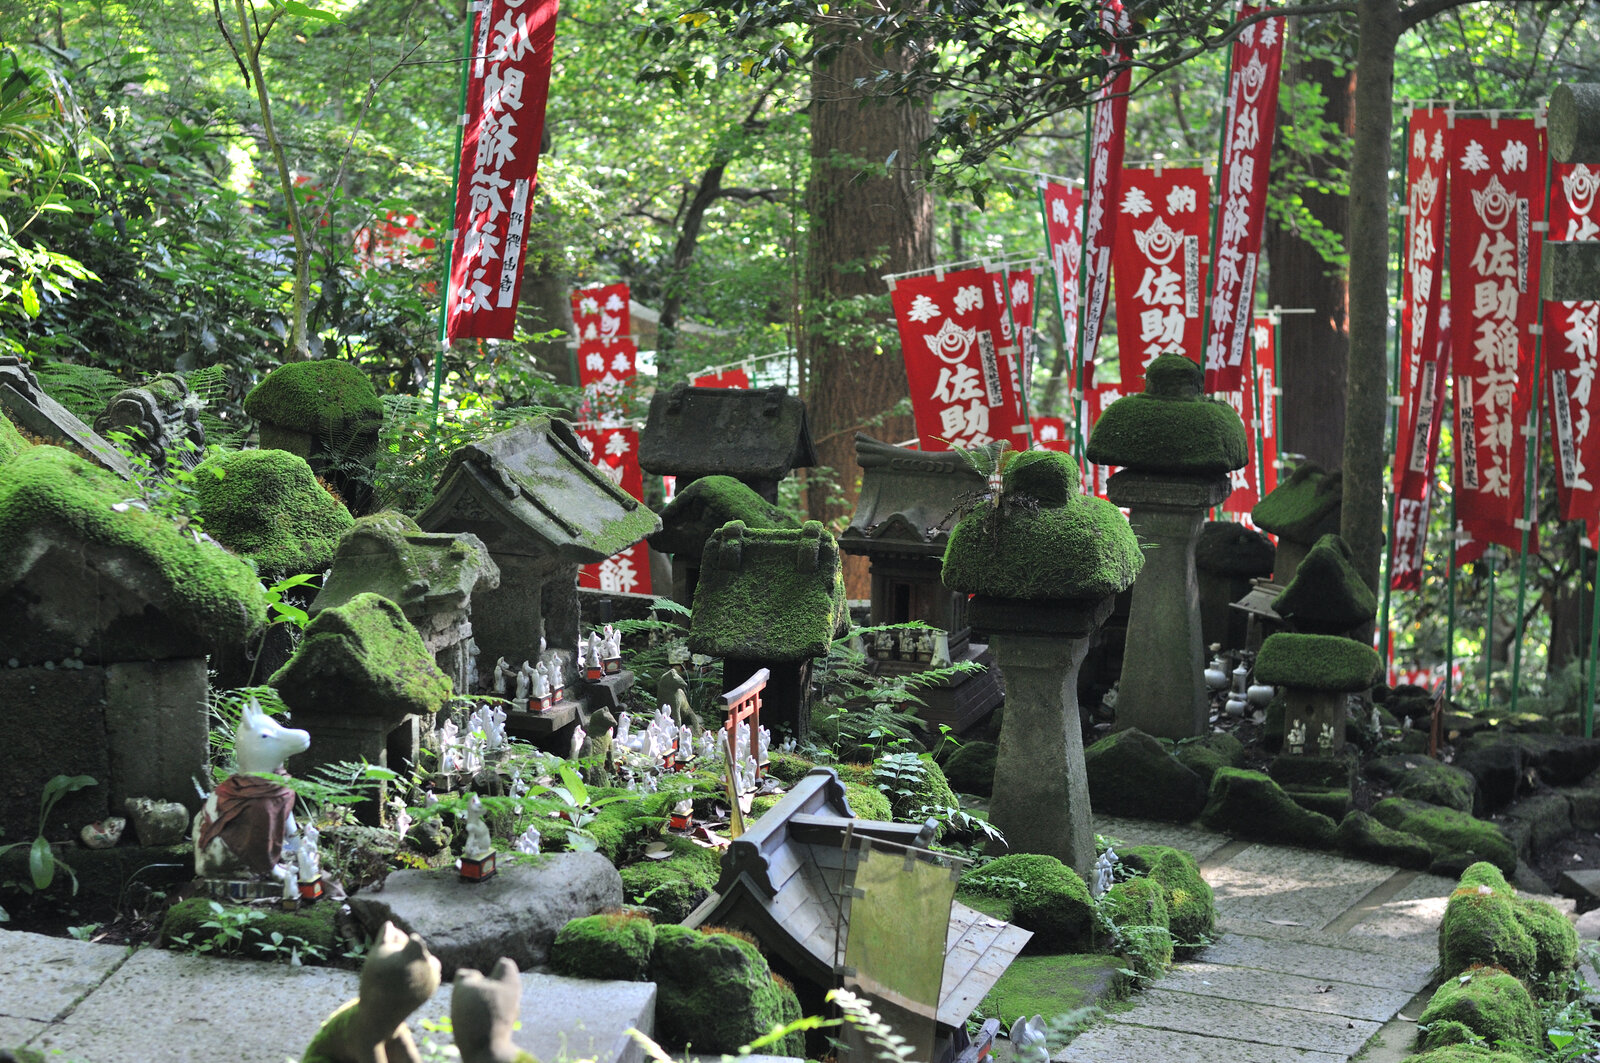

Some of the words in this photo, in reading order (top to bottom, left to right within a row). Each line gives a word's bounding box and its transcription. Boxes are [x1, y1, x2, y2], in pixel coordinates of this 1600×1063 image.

[1460, 139, 1528, 175] 奉納
[1120, 185, 1197, 218] 奉納
[907, 285, 984, 324] 奉納
[1469, 232, 1519, 499] 佐助稲荷神社
